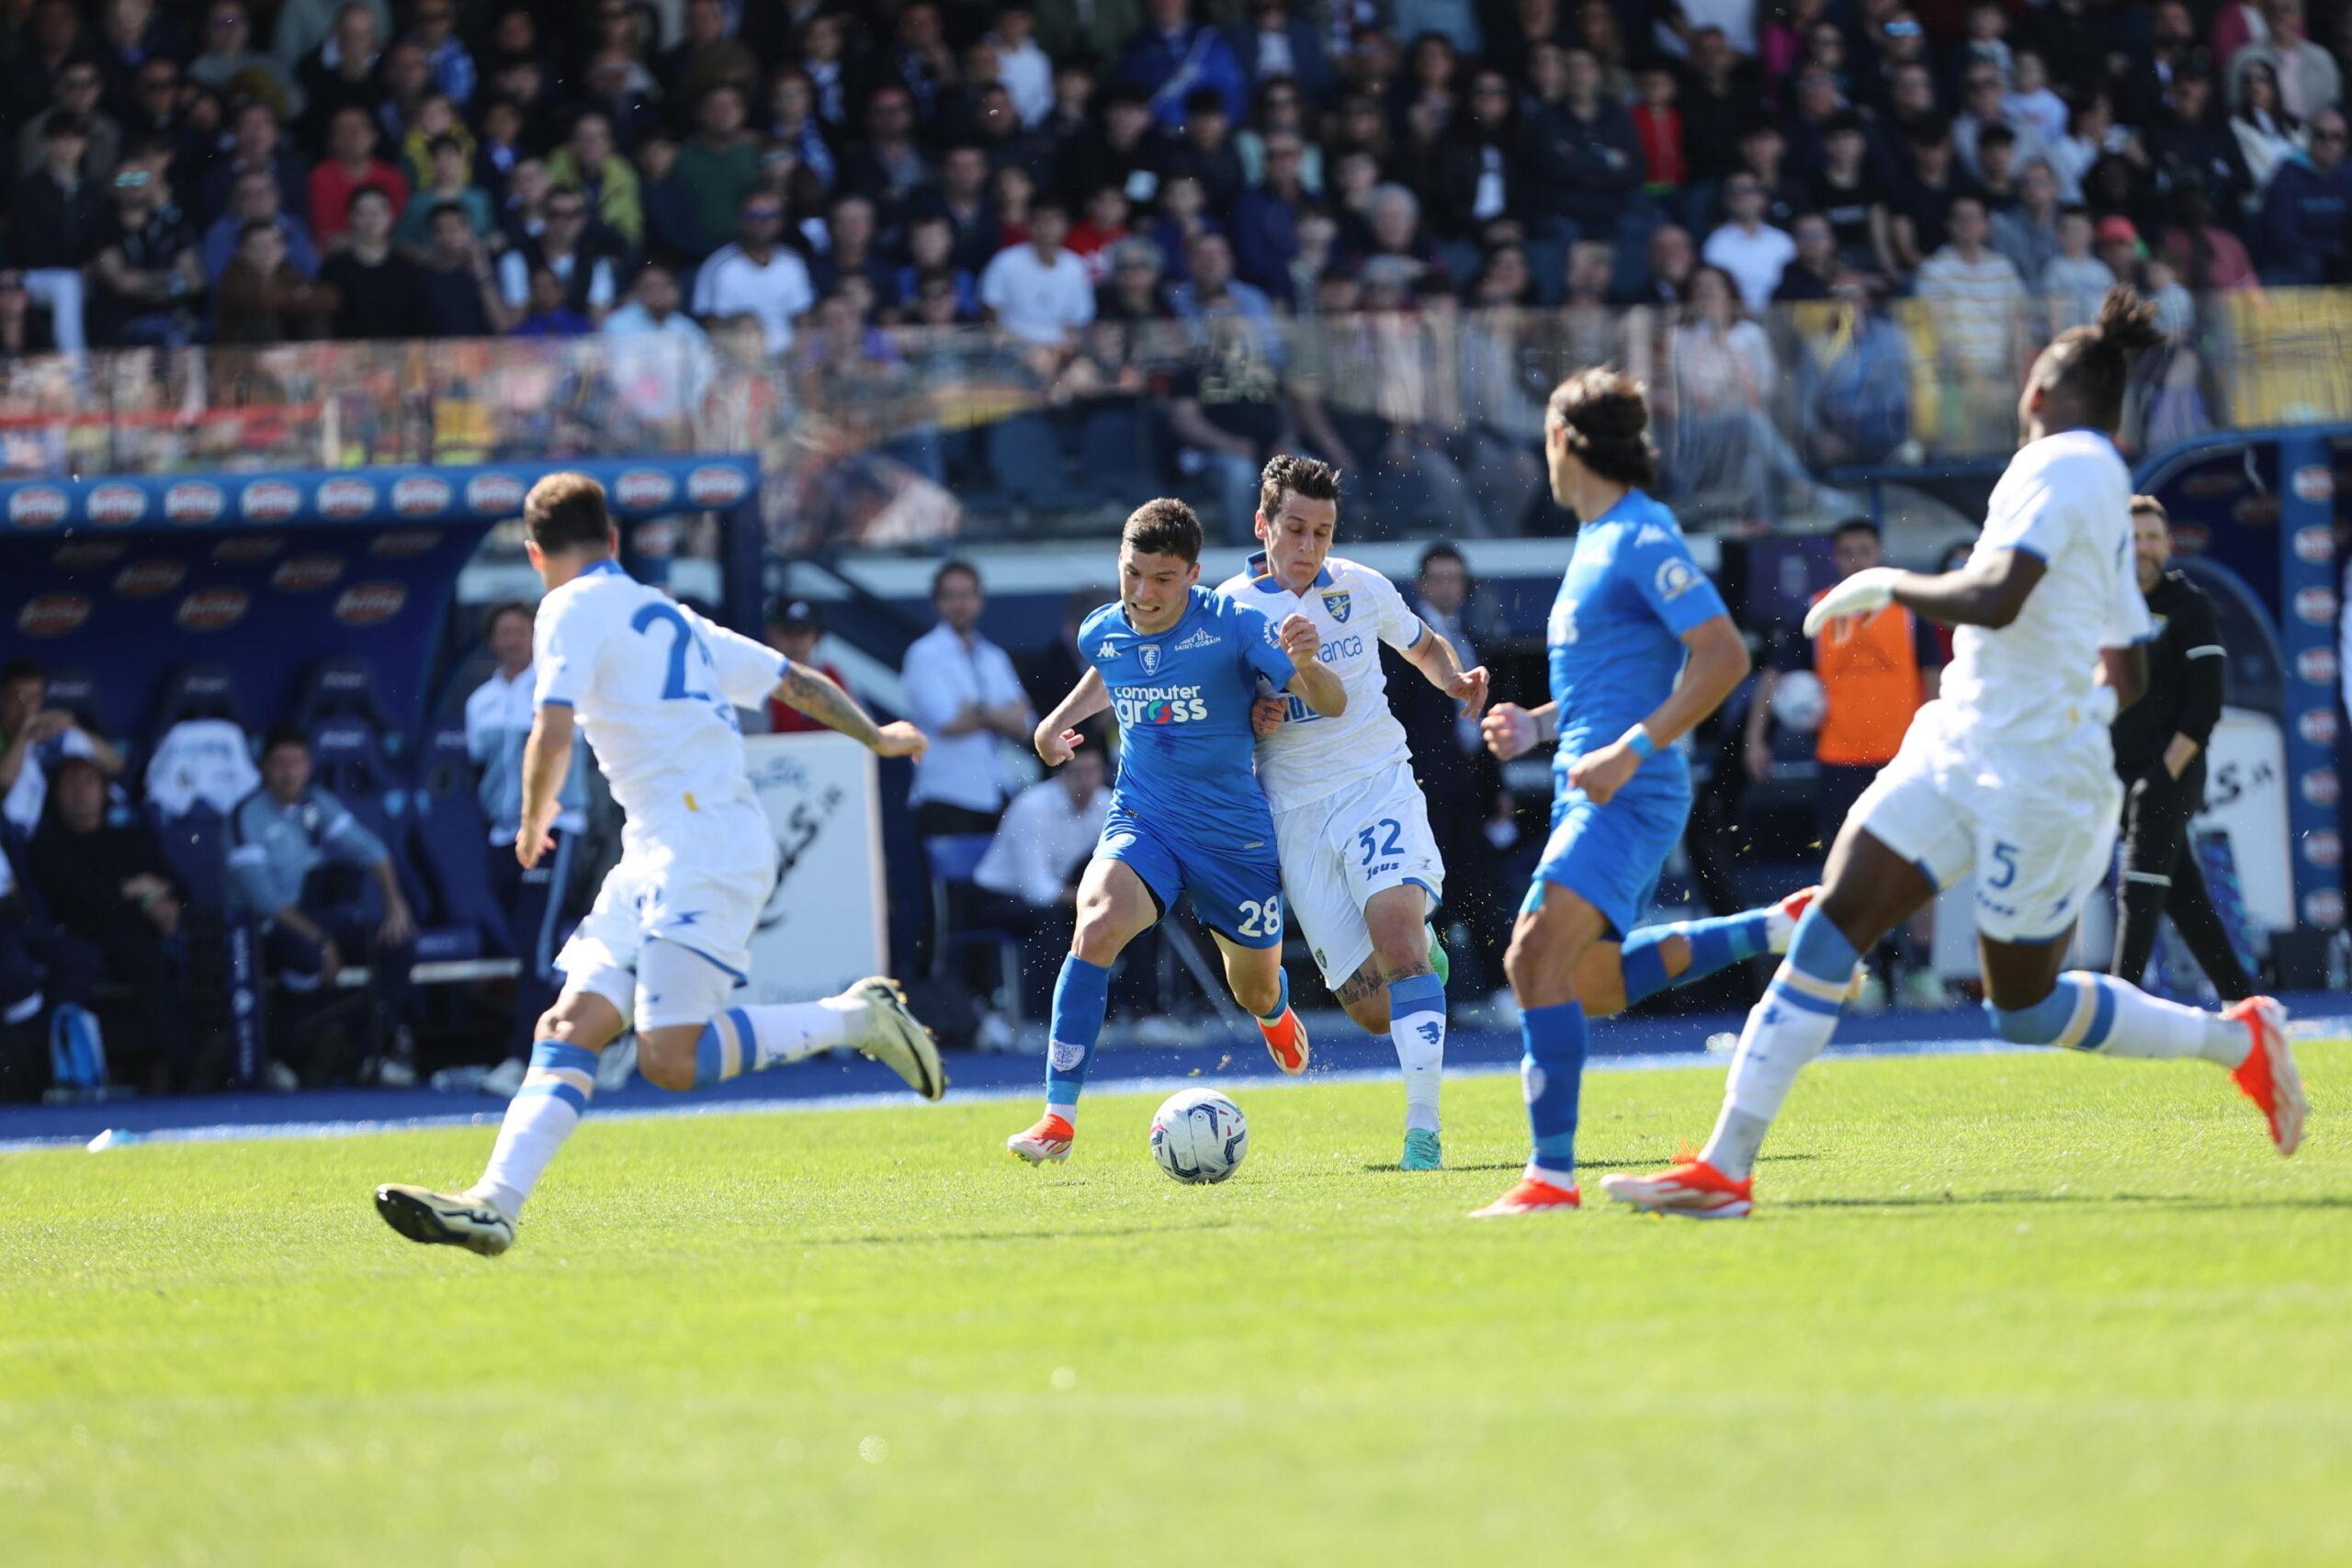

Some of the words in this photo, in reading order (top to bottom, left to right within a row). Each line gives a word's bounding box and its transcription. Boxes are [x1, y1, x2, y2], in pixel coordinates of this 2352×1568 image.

[1174, 636, 1221, 651] SAINT-GOBAIN
[1316, 636, 1363, 663] anca
[1114, 683, 1202, 703] computer
[1115, 697, 1208, 729] gross
[1358, 818, 1406, 866] 32
[1987, 841, 2019, 890] 5
[1238, 895, 1282, 937] 28
